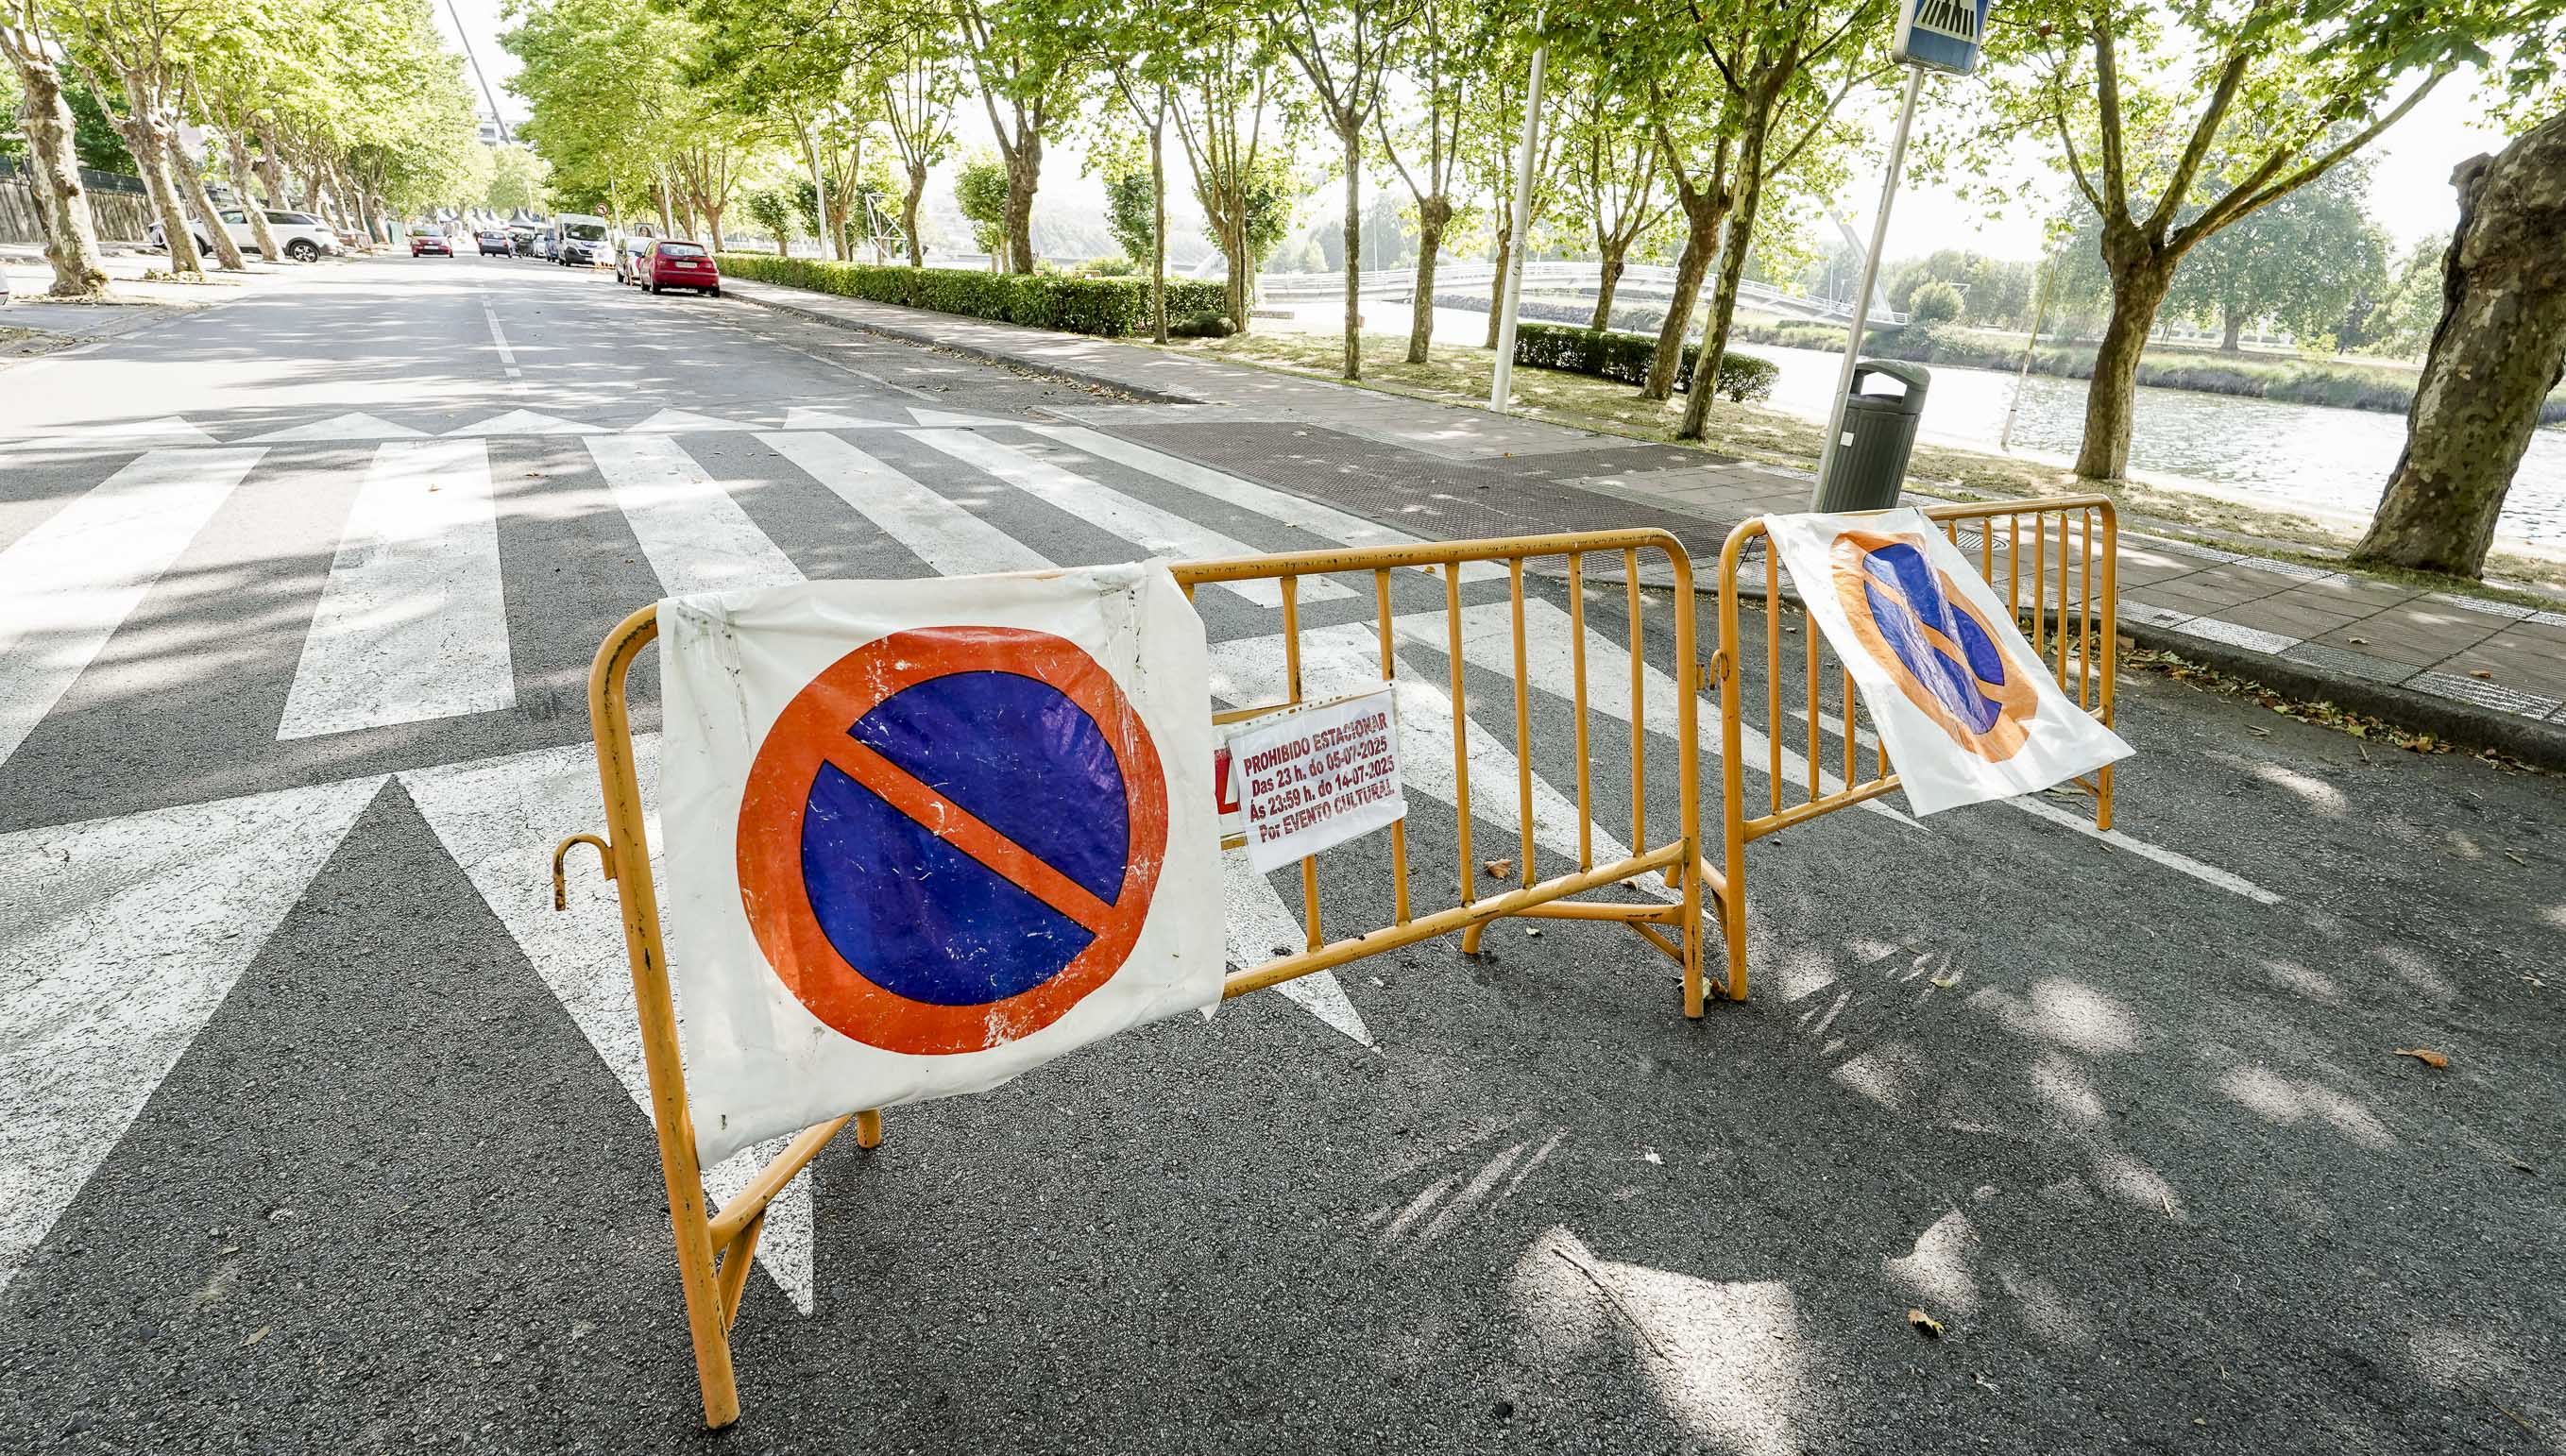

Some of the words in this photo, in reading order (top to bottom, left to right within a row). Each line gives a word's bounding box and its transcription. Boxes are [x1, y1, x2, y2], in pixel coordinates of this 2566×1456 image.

[1243, 736, 1311, 777] PROHIBIDO
[1313, 712, 1388, 753] ESTACIONAR
[1251, 776, 1275, 798] Das
[1276, 768, 1292, 788] 23
[1294, 765, 1306, 782] h.
[1308, 757, 1324, 777] do
[1325, 735, 1388, 771] 05-07-2025
[1249, 799, 1266, 822] Ás
[1267, 787, 1301, 816] 23:59
[1303, 785, 1316, 803] h.
[1317, 779, 1333, 797] do
[1334, 754, 1395, 791] 14-07-2025
[1259, 822, 1281, 843] Por
[1283, 801, 1332, 835] EVENTO
[1334, 778, 1395, 815] CULTURAL
